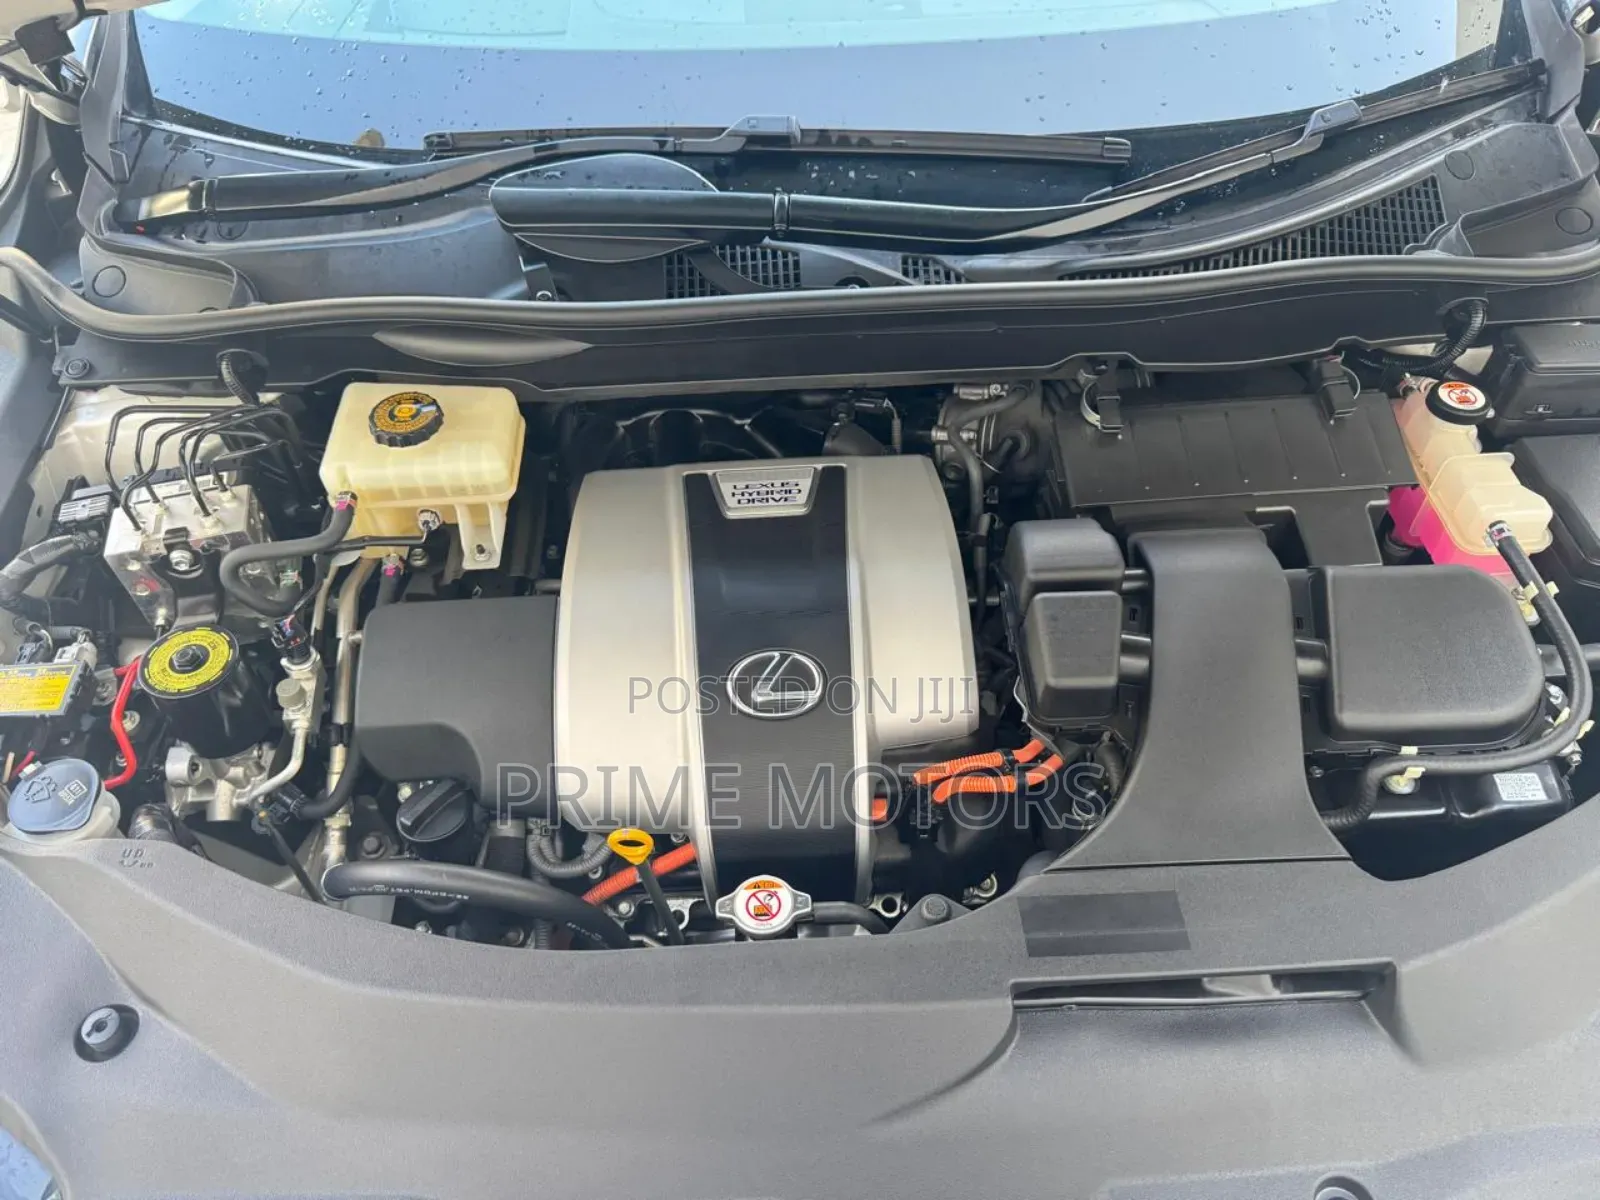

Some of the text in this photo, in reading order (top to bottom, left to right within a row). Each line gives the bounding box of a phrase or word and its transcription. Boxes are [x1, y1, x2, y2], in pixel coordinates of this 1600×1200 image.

[733, 480, 800, 490] LEXUS
[731, 488, 802, 497] HYBRID
[737, 496, 799, 505] DRIVE
